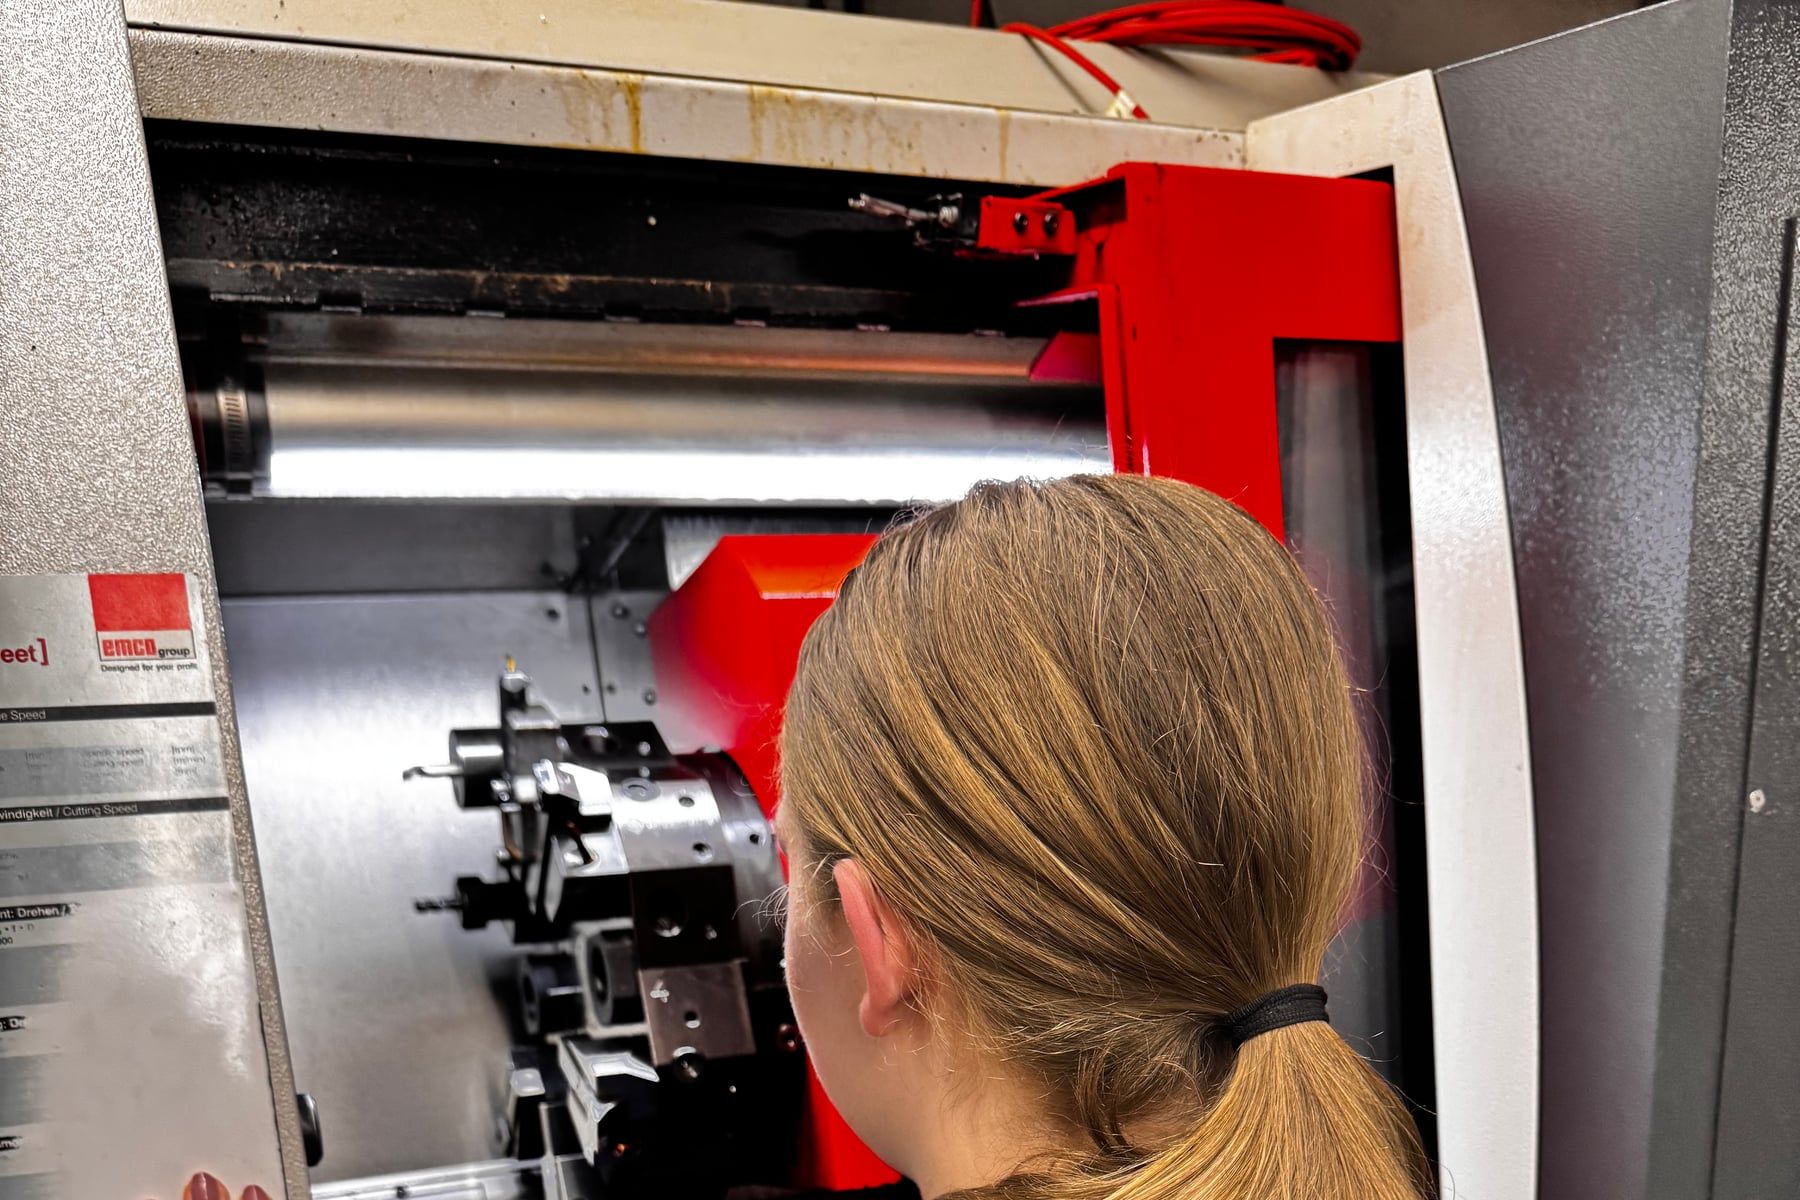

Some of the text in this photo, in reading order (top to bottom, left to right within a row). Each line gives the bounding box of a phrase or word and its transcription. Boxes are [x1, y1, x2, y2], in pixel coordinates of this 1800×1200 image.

[158, 648, 190, 659] group
[101, 664, 140, 673] Designed
[142, 663, 153, 671] for
[156, 663, 174, 672] your
[10, 710, 46, 722] Speed
[62, 806, 101, 818] Cutting
[104, 803, 138, 816] Speed
[17, 906, 60, 918] Drehen
